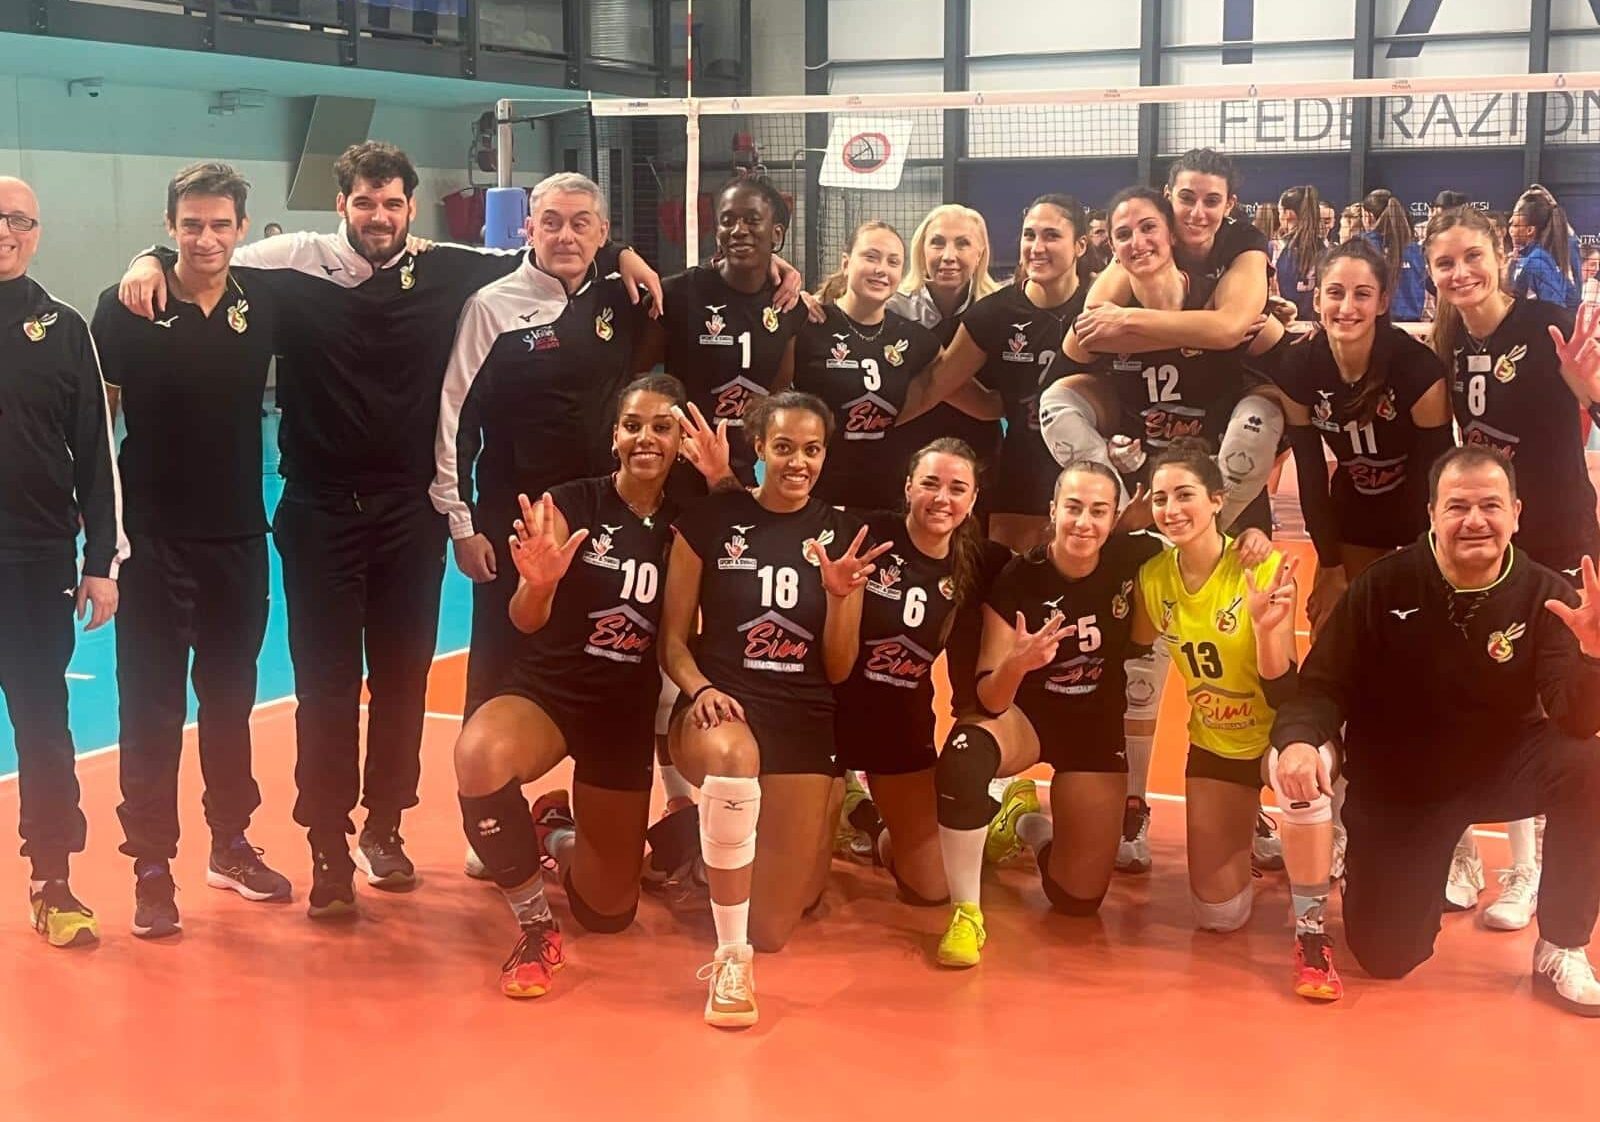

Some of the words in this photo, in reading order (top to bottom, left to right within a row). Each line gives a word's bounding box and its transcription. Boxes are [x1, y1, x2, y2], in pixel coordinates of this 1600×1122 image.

[738, 332, 751, 368] 1
[861, 358, 881, 391] 3
[1141, 364, 1182, 403] 12
[1468, 375, 1487, 416] 8
[1343, 420, 1377, 454] 11
[620, 559, 658, 604] 10
[757, 565, 799, 609] 18
[903, 586, 928, 628] 6
[744, 622, 808, 659] Sim
[1077, 614, 1102, 652] 5
[1180, 641, 1223, 679] 13
